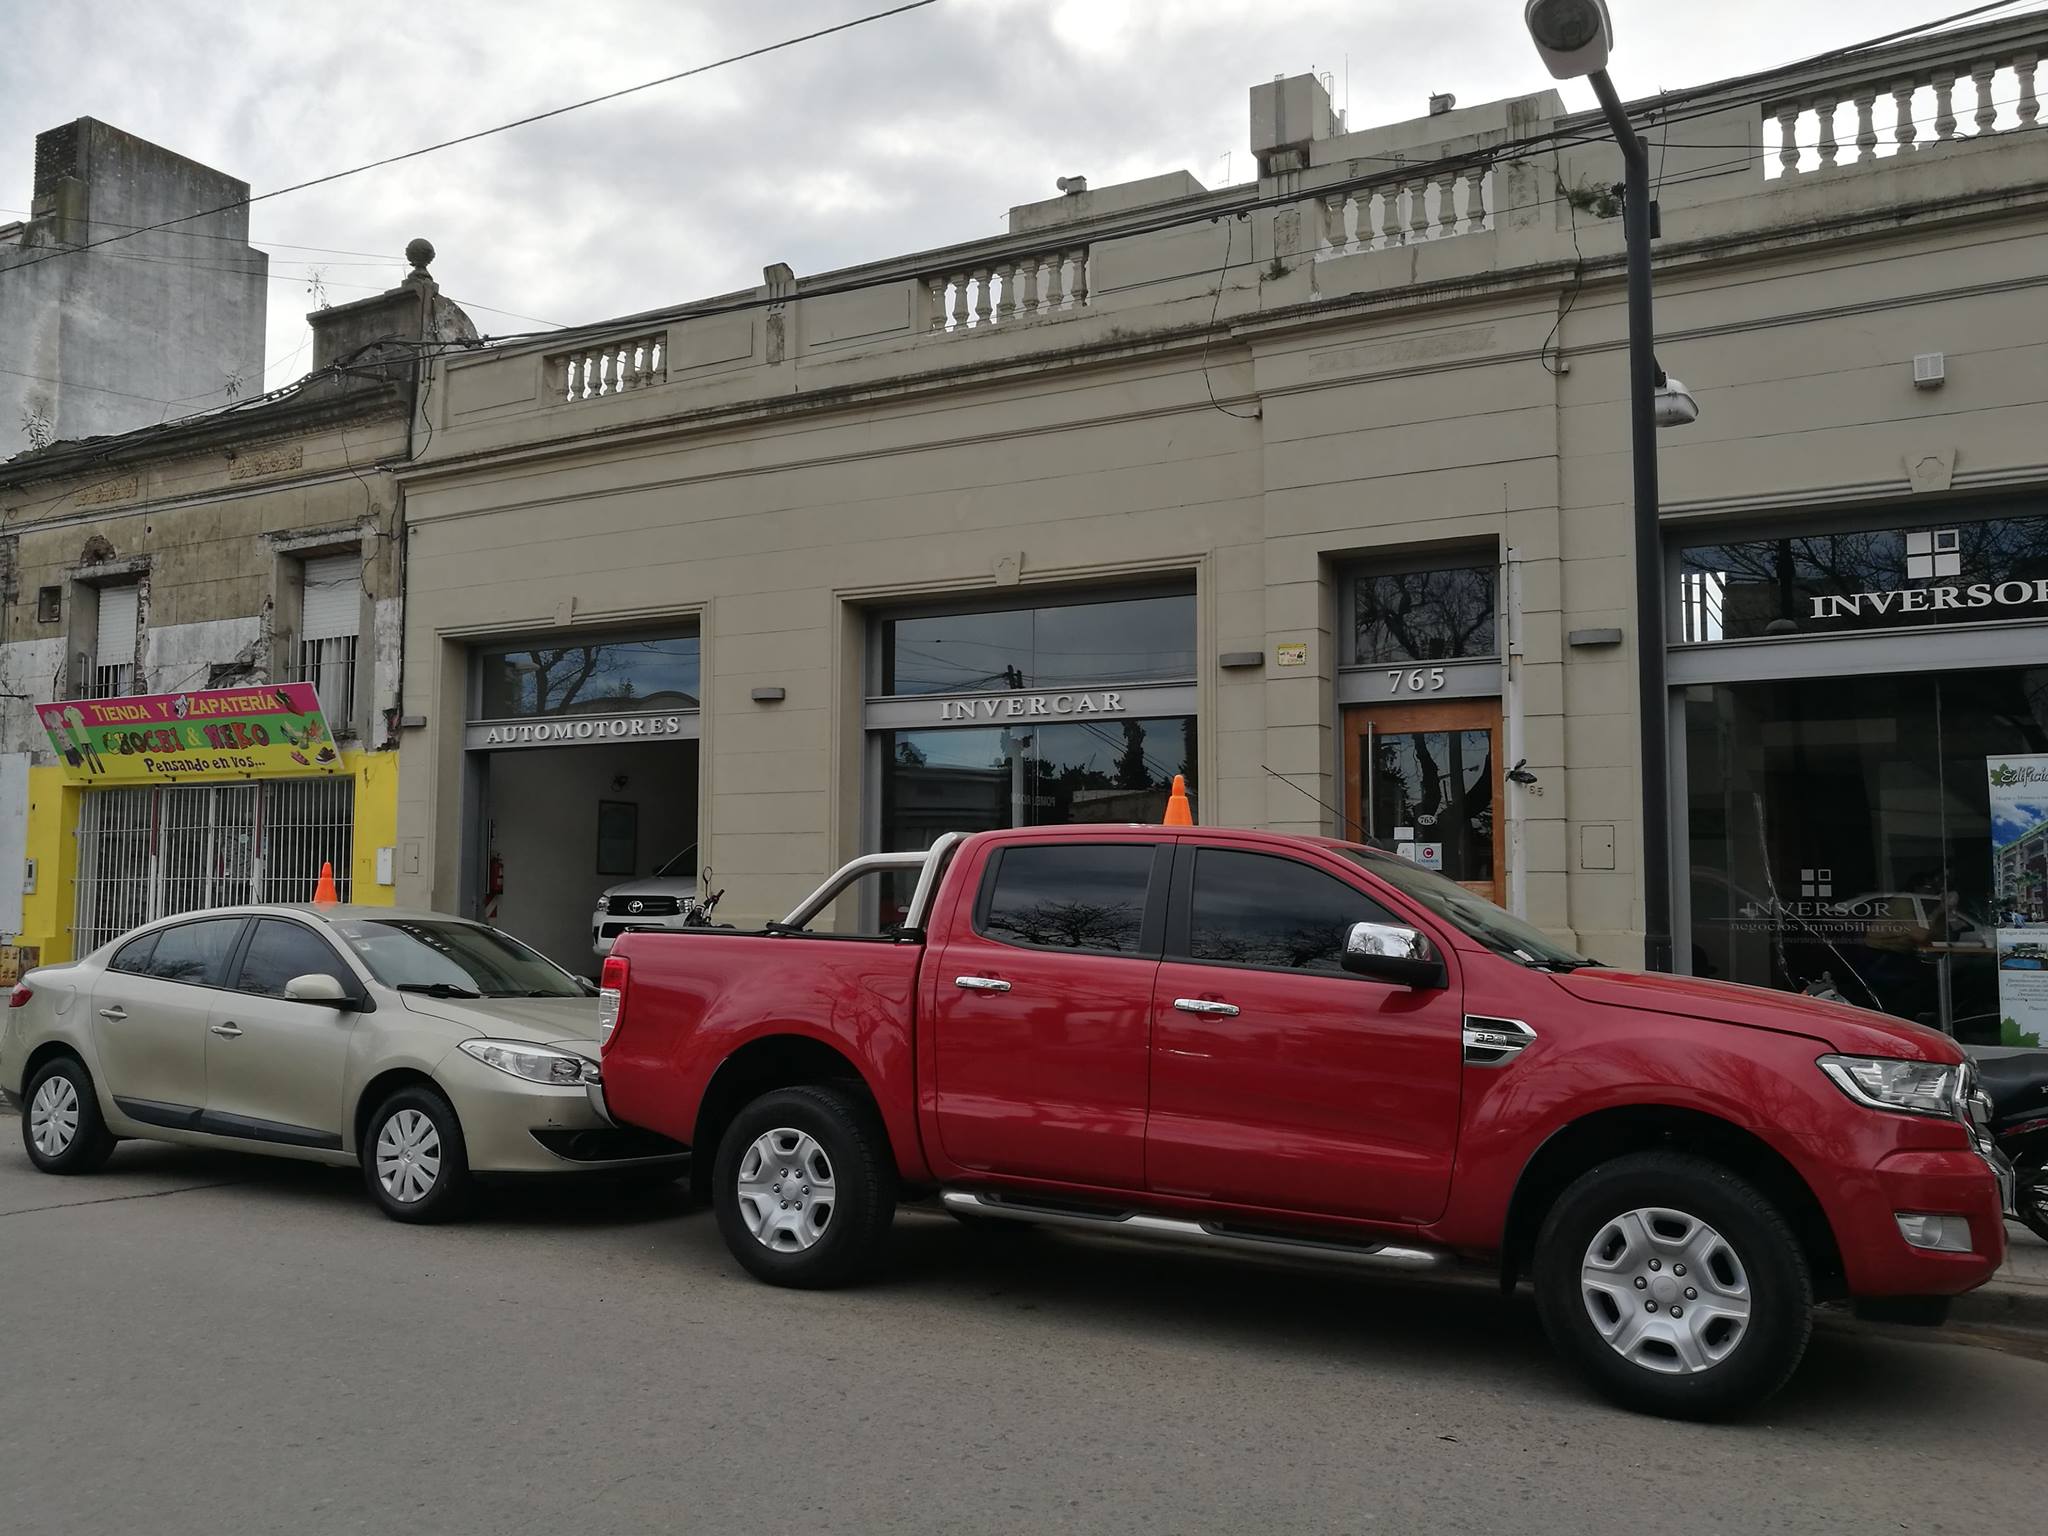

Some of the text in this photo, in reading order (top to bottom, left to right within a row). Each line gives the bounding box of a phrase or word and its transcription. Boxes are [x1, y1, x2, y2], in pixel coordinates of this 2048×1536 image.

[1387, 667, 1445, 693] 765
[90, 690, 280, 722] TIENDA Y ZAPATERÍA
[940, 692, 1126, 720] INVERCAR
[186, 727, 202, 747] &
[486, 716, 680, 744] AUTOMOTORES
[144, 757, 210, 773] Pensando
[213, 757, 230, 768] en
[1745, 902, 1892, 917] INVERSOR
[1730, 920, 1912, 934] negocios inmobiliarios
